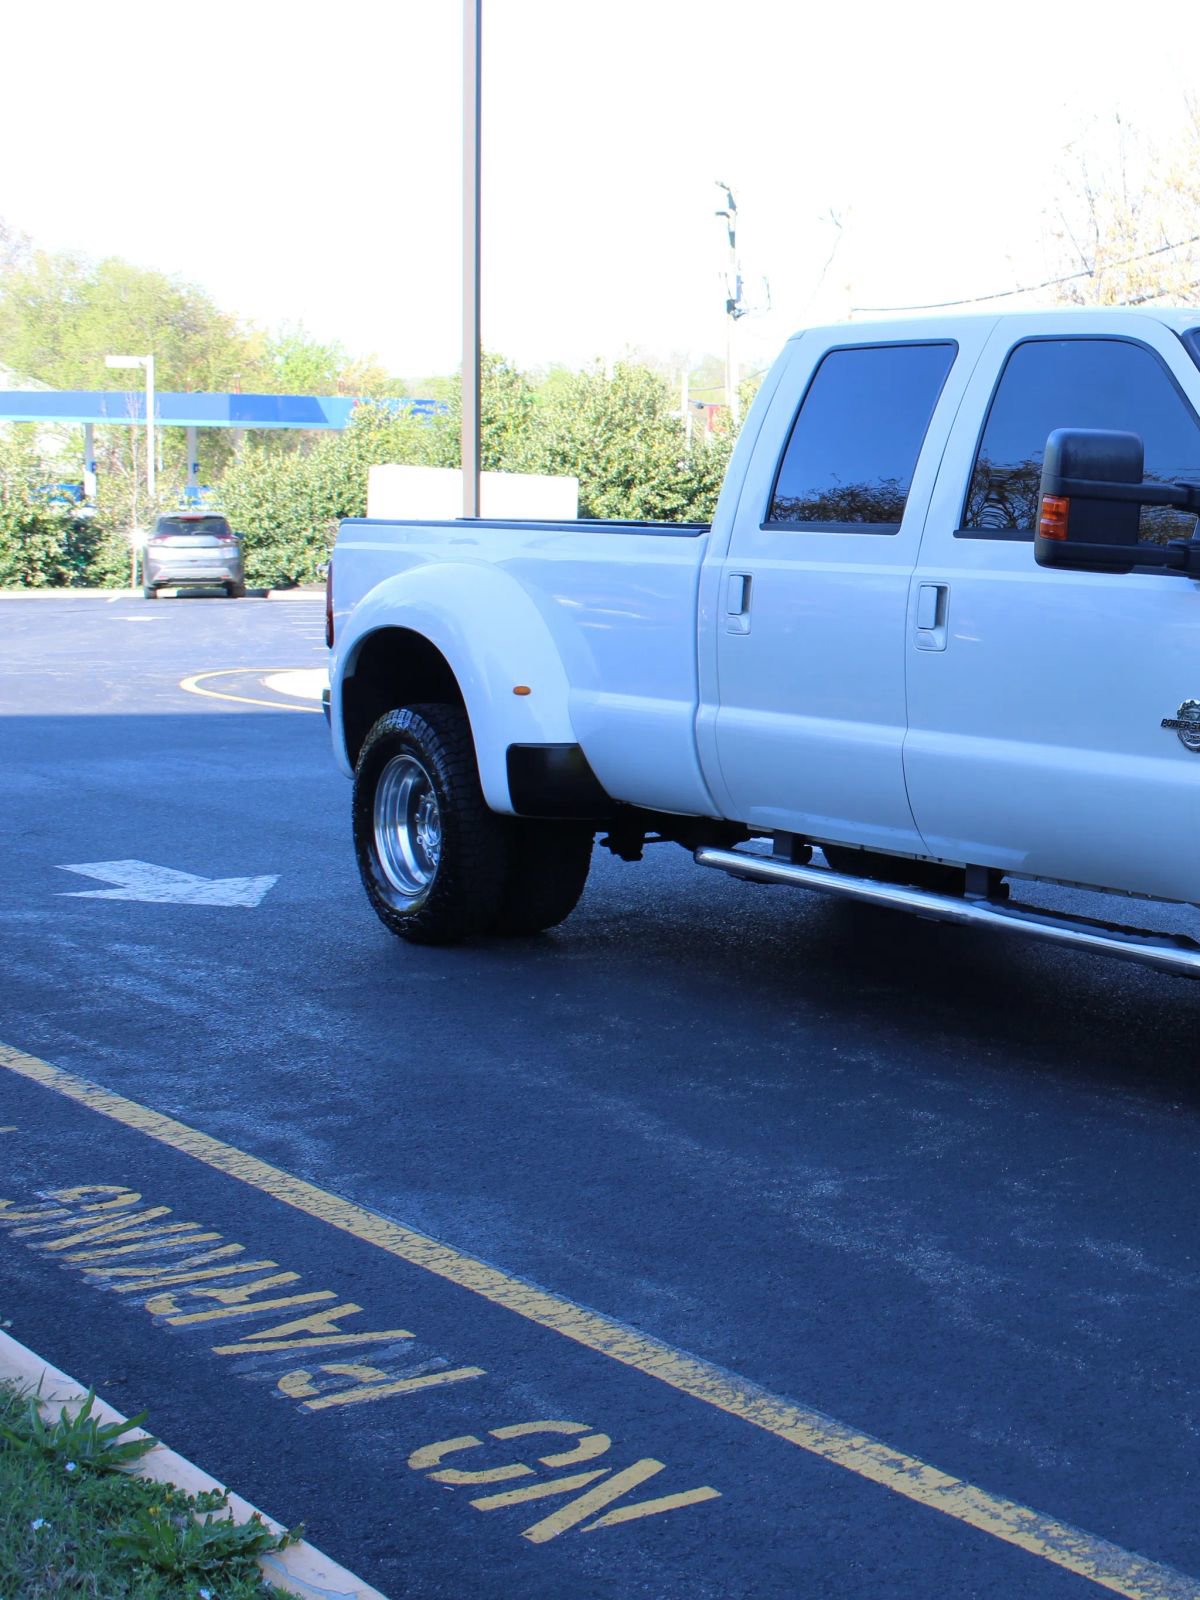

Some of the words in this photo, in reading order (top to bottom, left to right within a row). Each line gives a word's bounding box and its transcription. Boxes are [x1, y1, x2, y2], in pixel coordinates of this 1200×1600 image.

[1161, 719, 1190, 729] POWER
[0, 1184, 487, 1412] PARKING
[409, 1420, 722, 1545] NO
